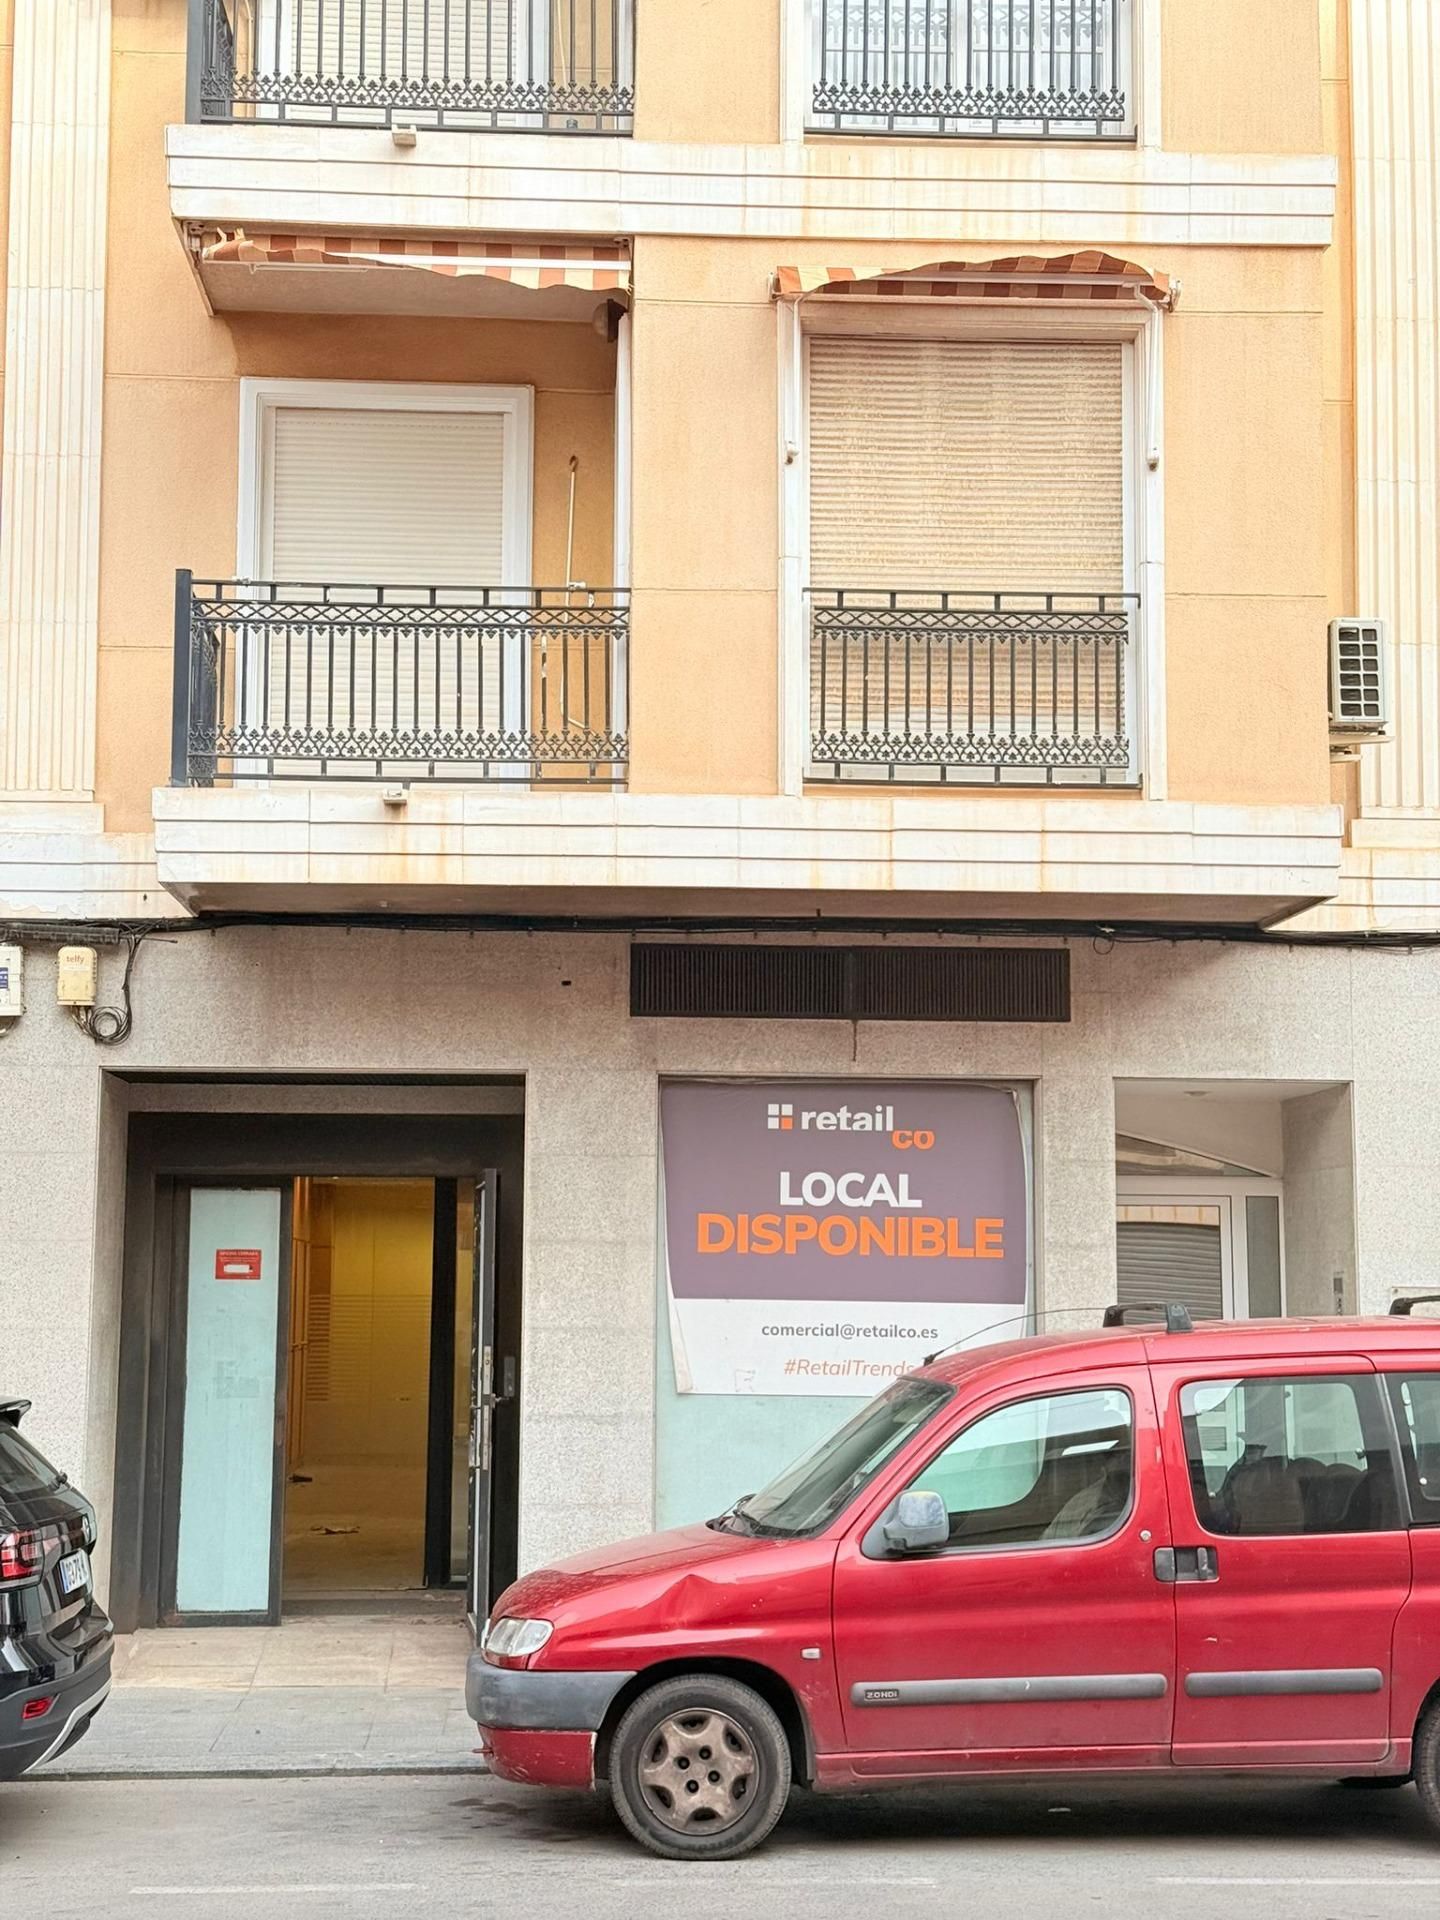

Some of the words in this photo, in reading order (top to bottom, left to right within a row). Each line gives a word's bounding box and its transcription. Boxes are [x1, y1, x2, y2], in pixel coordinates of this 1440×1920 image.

[801, 1105, 894, 1132] retail
[779, 1171, 923, 1208] LOCAL
[696, 1213, 1005, 1260] DISPONIBLE
[761, 1324, 939, 1341] comercial@retailco.es
